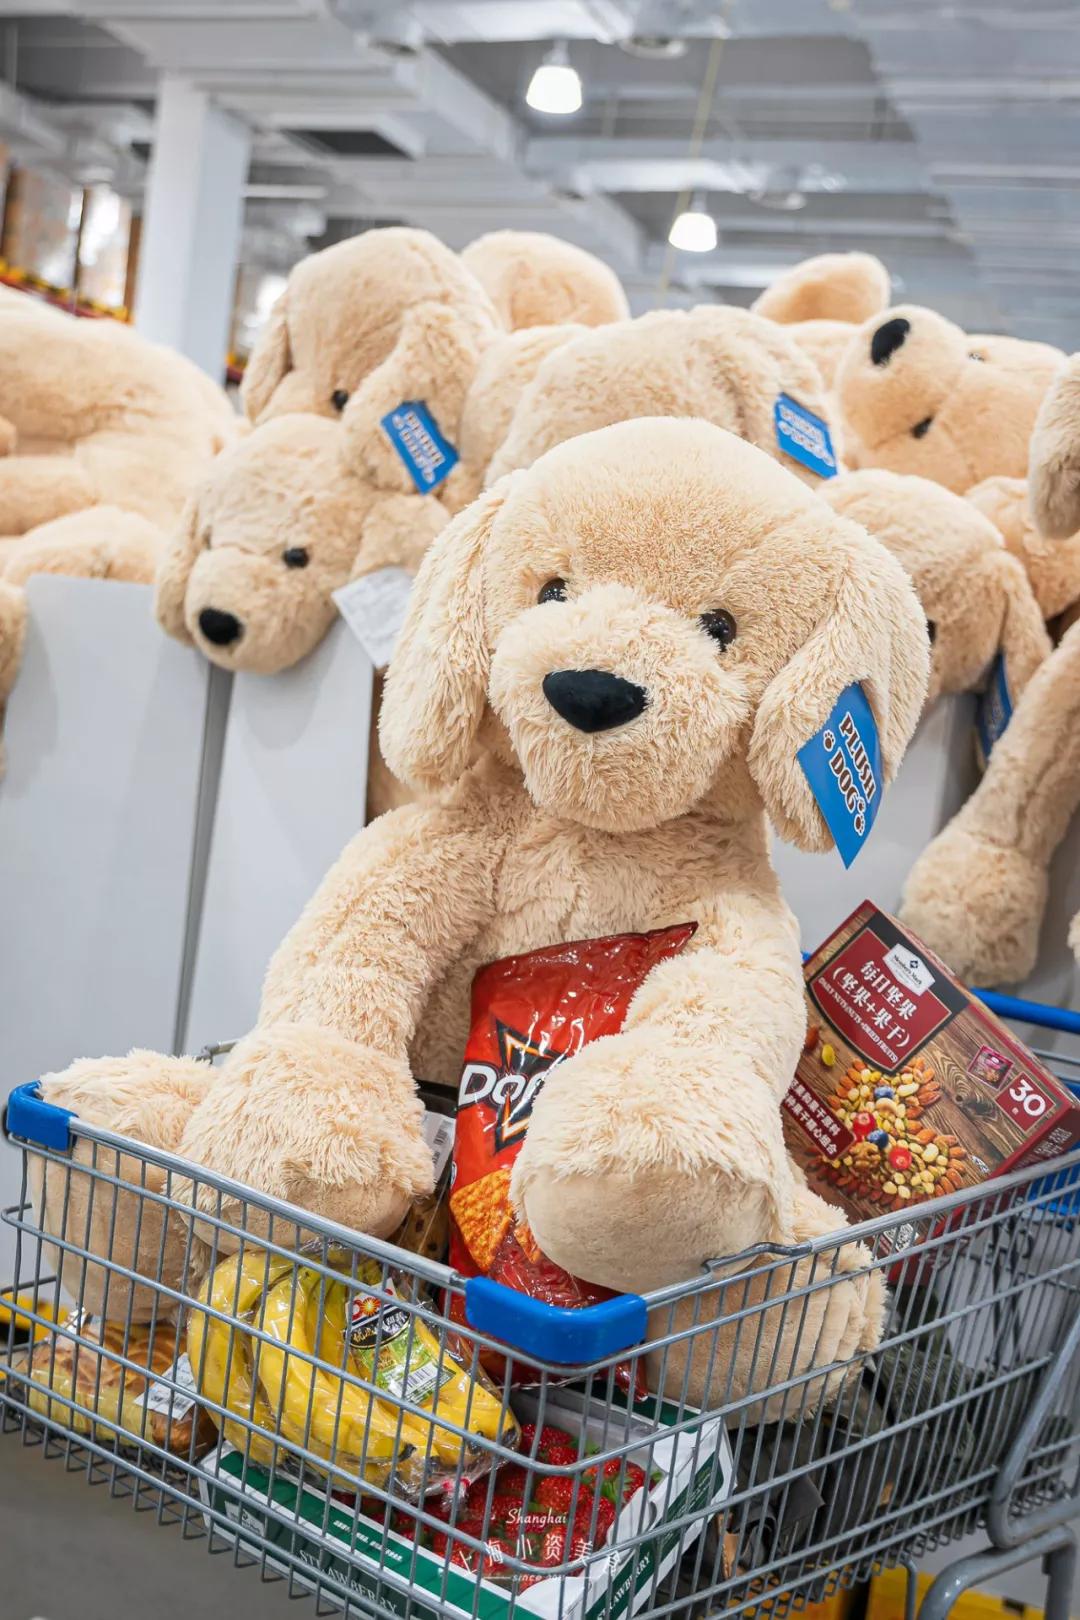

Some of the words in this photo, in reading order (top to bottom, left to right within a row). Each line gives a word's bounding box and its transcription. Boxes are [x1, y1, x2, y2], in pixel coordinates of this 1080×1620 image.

[829, 747, 859, 813] DOG
[839, 711, 876, 803] PLUSH
[861, 960, 917, 1020] 每日坚果
[1009, 1078, 1046, 1116] 30
[299, 1549, 398, 1614] STAWBERRY
